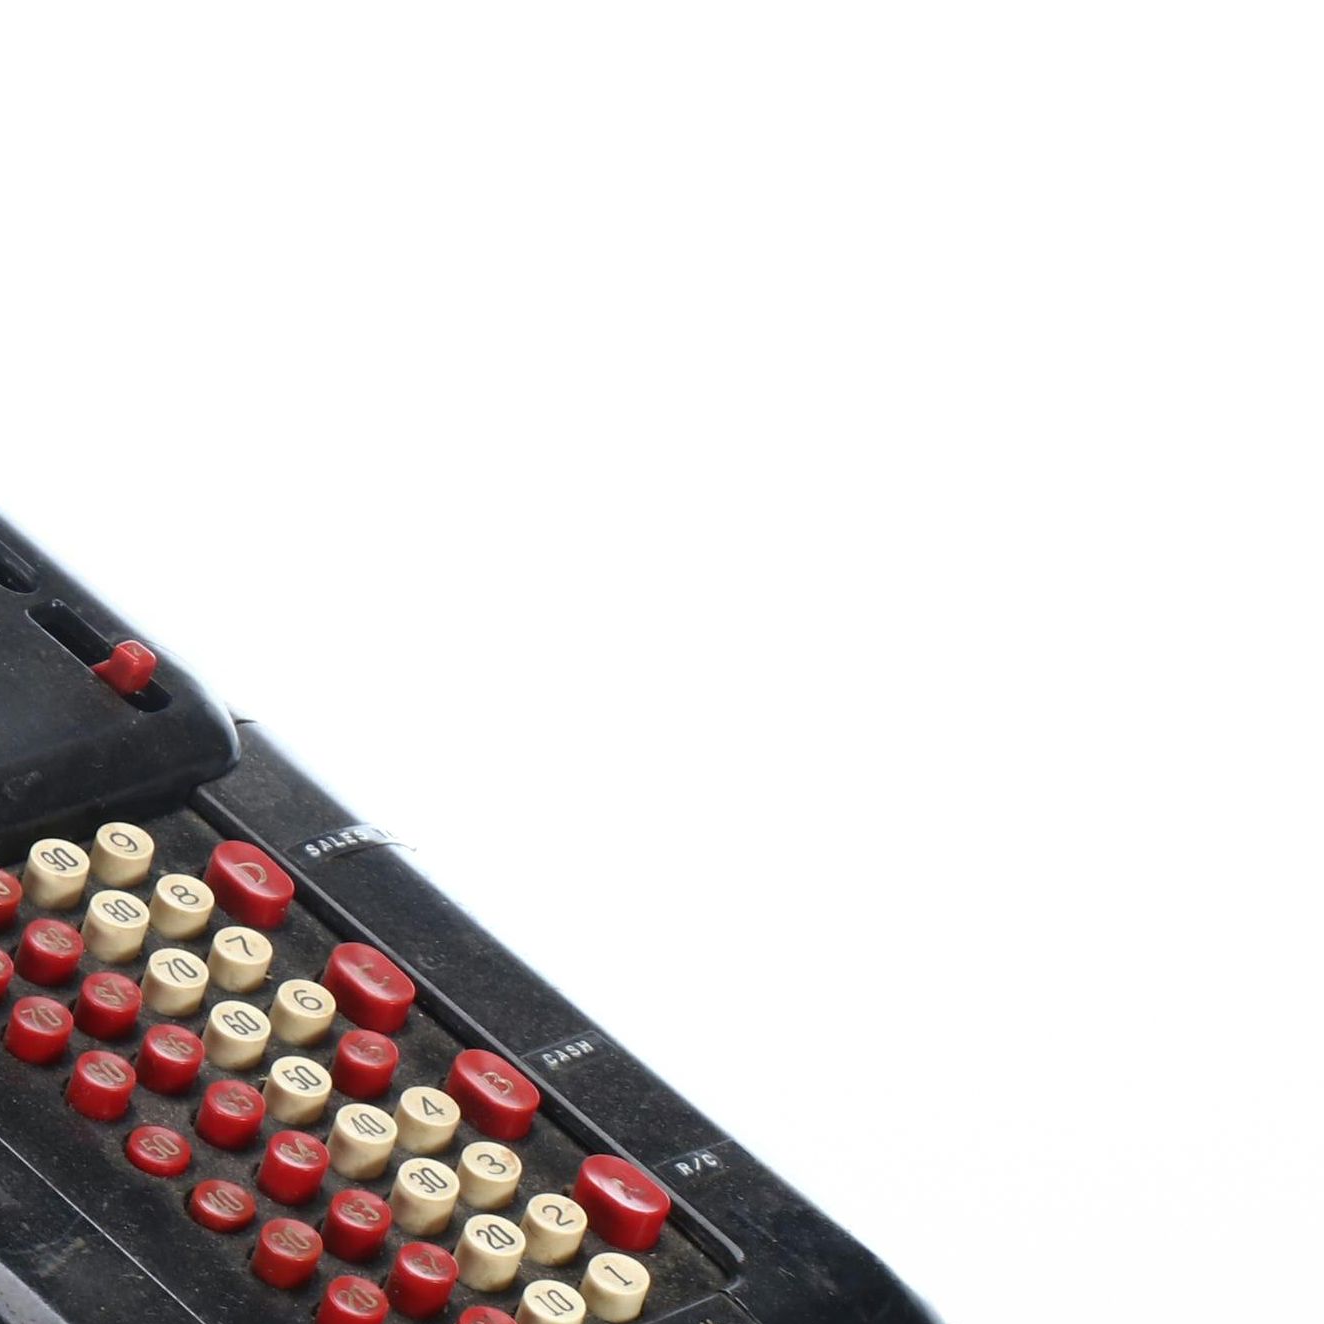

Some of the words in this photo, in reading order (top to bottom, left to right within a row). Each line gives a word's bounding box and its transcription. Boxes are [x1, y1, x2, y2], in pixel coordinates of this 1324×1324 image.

[109, 832, 138, 854] 9
[305, 829, 370, 857] SALES
[40, 847, 78, 871] 90
[236, 862, 268, 886] D
[170, 884, 199, 906] 8
[102, 899, 140, 922] 80
[225, 935, 253, 957] 7
[158, 958, 198, 982] 70
[293, 989, 323, 1011] 6
[20, 1007, 62, 1031] 70
[222, 1011, 260, 1035] 60
[542, 1039, 595, 1067] CASH
[86, 1062, 127, 1087] 60
[282, 1065, 322, 1090] 50
[481, 1072, 513, 1095] B
[421, 1096, 445, 1118] 4
[350, 1114, 388, 1138] 40
[140, 1134, 181, 1160] 50
[477, 1153, 507, 1176] 3
[676, 1153, 717, 1177] R/C
[408, 1167, 448, 1193] 30
[205, 1190, 246, 1216] 40
[543, 1204, 575, 1227] 2
[271, 1227, 311, 1253] 30
[476, 1224, 516, 1251] 20
[603, 1264, 632, 1287] 1
[337, 1286, 378, 1313] 20
[534, 1289, 572, 1316] 10
